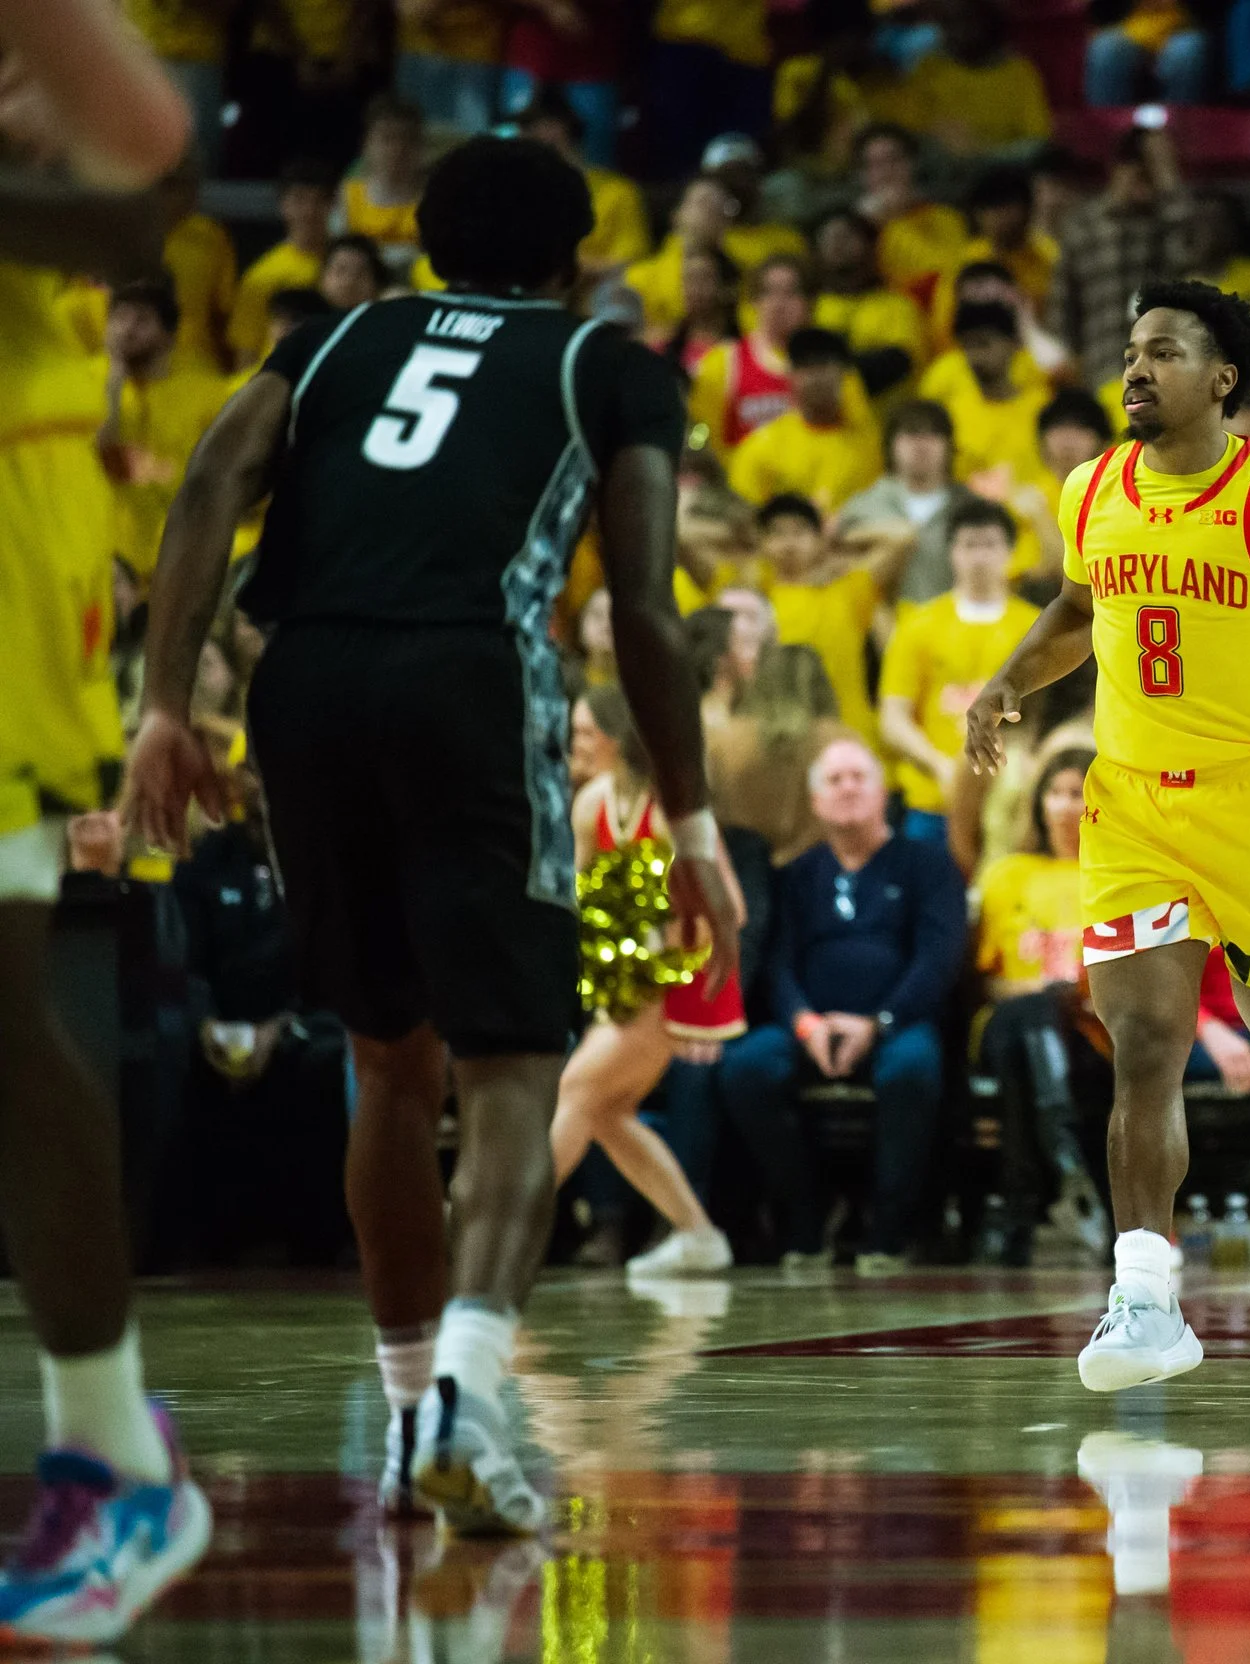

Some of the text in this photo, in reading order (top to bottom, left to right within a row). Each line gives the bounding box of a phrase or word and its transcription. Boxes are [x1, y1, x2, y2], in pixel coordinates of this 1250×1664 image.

[361, 341, 483, 471] 5
[1088, 553, 1249, 610] MARYLAND
[1136, 604, 1184, 698] 8
